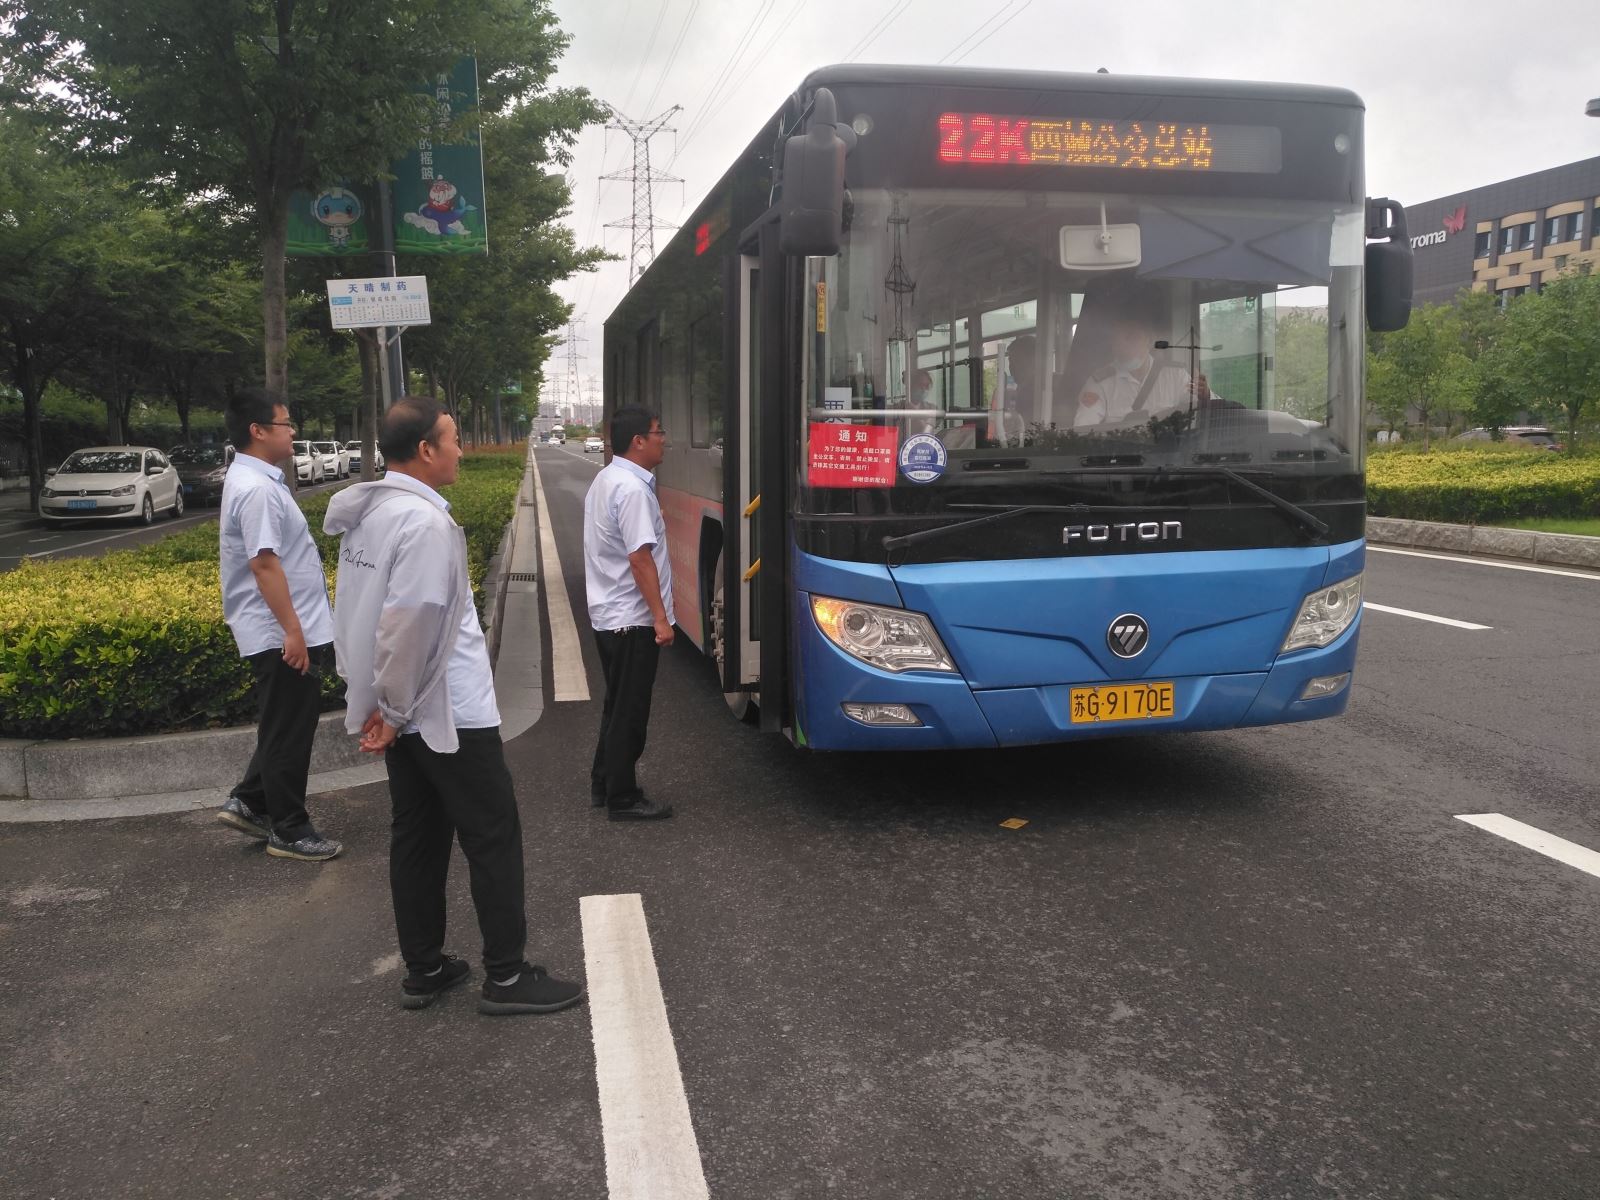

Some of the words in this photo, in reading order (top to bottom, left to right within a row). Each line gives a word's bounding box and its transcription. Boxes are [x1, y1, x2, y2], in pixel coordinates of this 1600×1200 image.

[939, 112, 1031, 162] 22K
[348, 281, 407, 294] 天晴制药
[838, 429, 867, 442] 通知
[1063, 521, 1182, 544] FOTON
